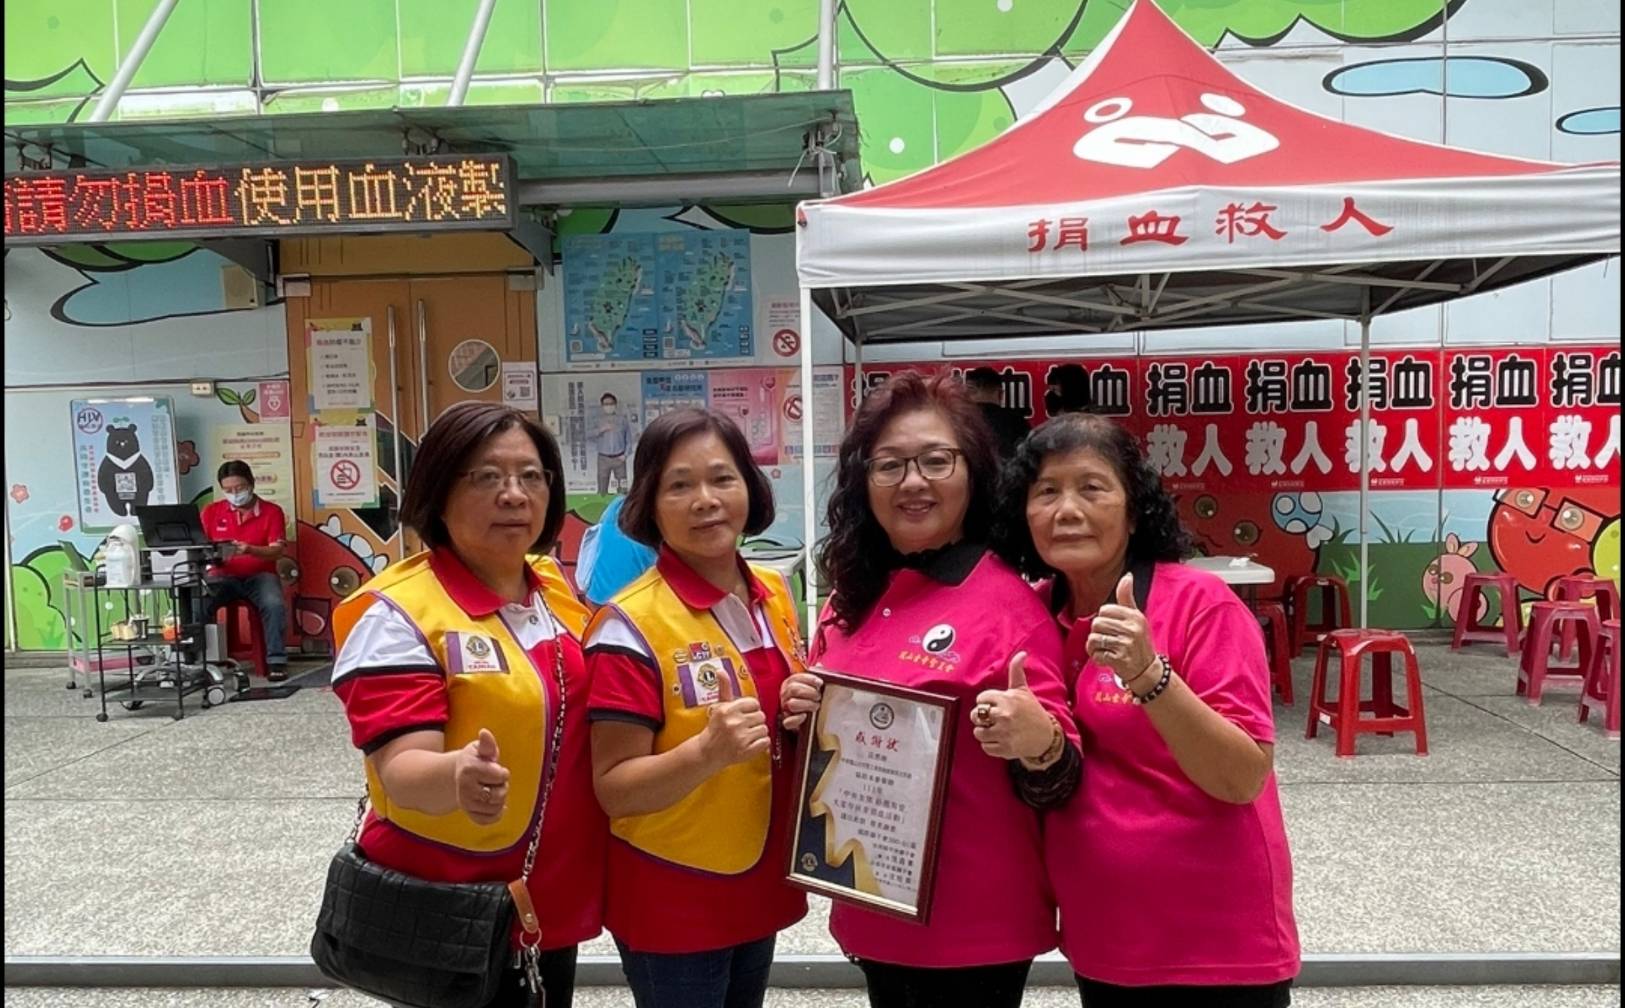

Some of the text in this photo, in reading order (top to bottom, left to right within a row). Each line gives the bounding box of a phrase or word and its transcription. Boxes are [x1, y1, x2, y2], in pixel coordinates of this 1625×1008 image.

[5, 160, 505, 233] 請勿捐血使用血液製
[1027, 196, 1394, 253] 捐血救人
[951, 366, 1034, 418] 血
[1044, 363, 1132, 418] 血
[1145, 361, 1234, 417] 捐血
[1245, 358, 1334, 414] 捐血
[1345, 355, 1434, 411] 捐血
[1449, 353, 1539, 409] 捐血
[1550, 351, 1620, 407] 捐血
[1146, 423, 1233, 478] 救人
[1245, 420, 1333, 476] 救人
[1345, 417, 1433, 473] 救人
[1449, 416, 1537, 472] 救人
